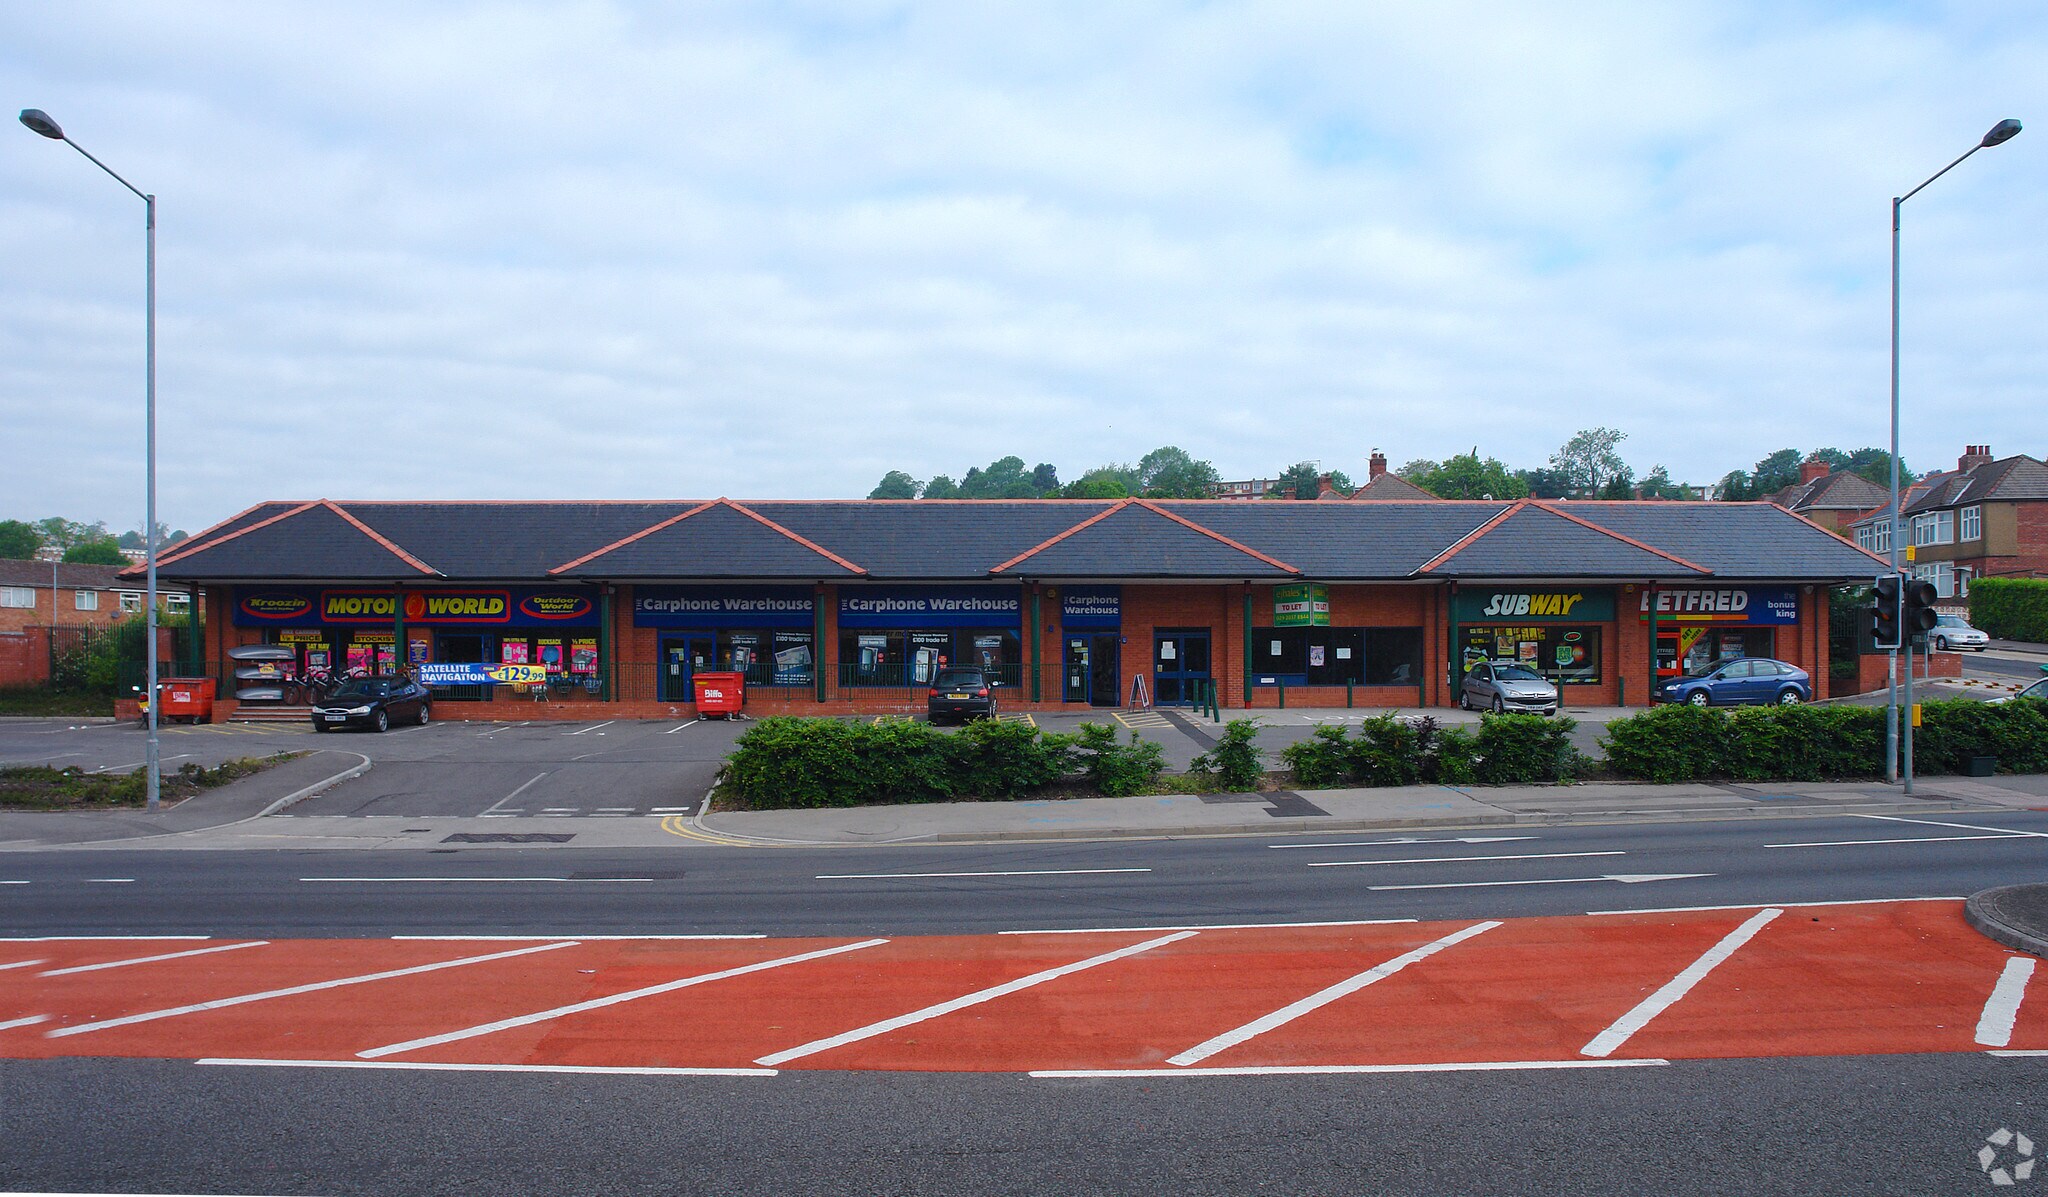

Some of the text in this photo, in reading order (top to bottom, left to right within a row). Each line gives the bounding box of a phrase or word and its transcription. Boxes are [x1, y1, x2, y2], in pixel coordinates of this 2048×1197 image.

[1783, 592, 1796, 600] the
[250, 598, 306, 607] Kroozin
[643, 597, 720, 612] Carphone
[723, 597, 813, 610] Warehouse
[849, 597, 926, 612] Carphone
[929, 597, 1018, 610] Warehouse
[1069, 596, 1119, 606] Carphone
[1483, 592, 1583, 616] SUBWAY
[1767, 600, 1796, 609] bonus
[429, 597, 505, 615] WORLD
[1064, 606, 1119, 614] Warehouse
[1776, 609, 1796, 618] king
[420, 664, 471, 673] SATELLITE
[421, 673, 485, 681] NAVIGATION
[498, 666, 544, 681] £129.99
[704, 689, 723, 698] Biffa
